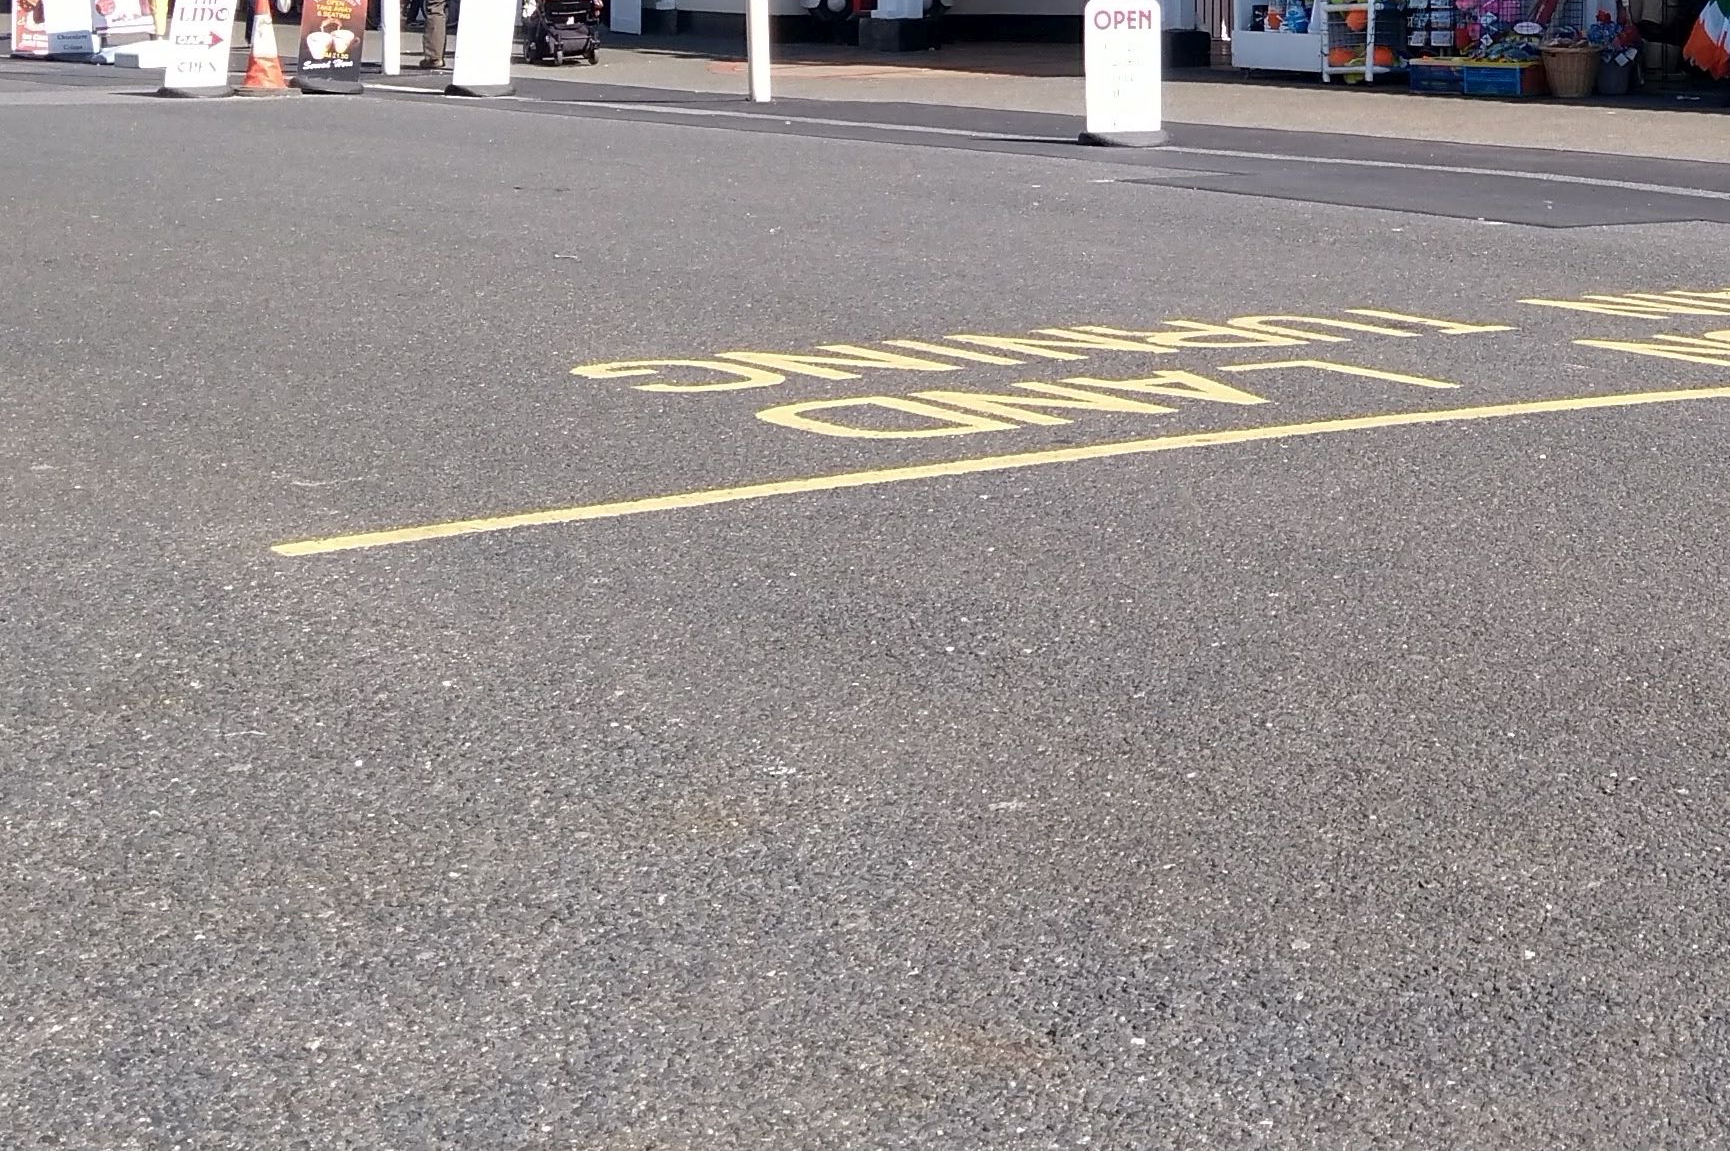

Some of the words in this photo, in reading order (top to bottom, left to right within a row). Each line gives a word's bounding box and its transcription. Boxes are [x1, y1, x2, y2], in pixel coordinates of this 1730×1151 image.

[1094, 10, 1152, 30] OPEN
[570, 309, 1518, 392] TURNING
[755, 360, 1461, 439] LAND
